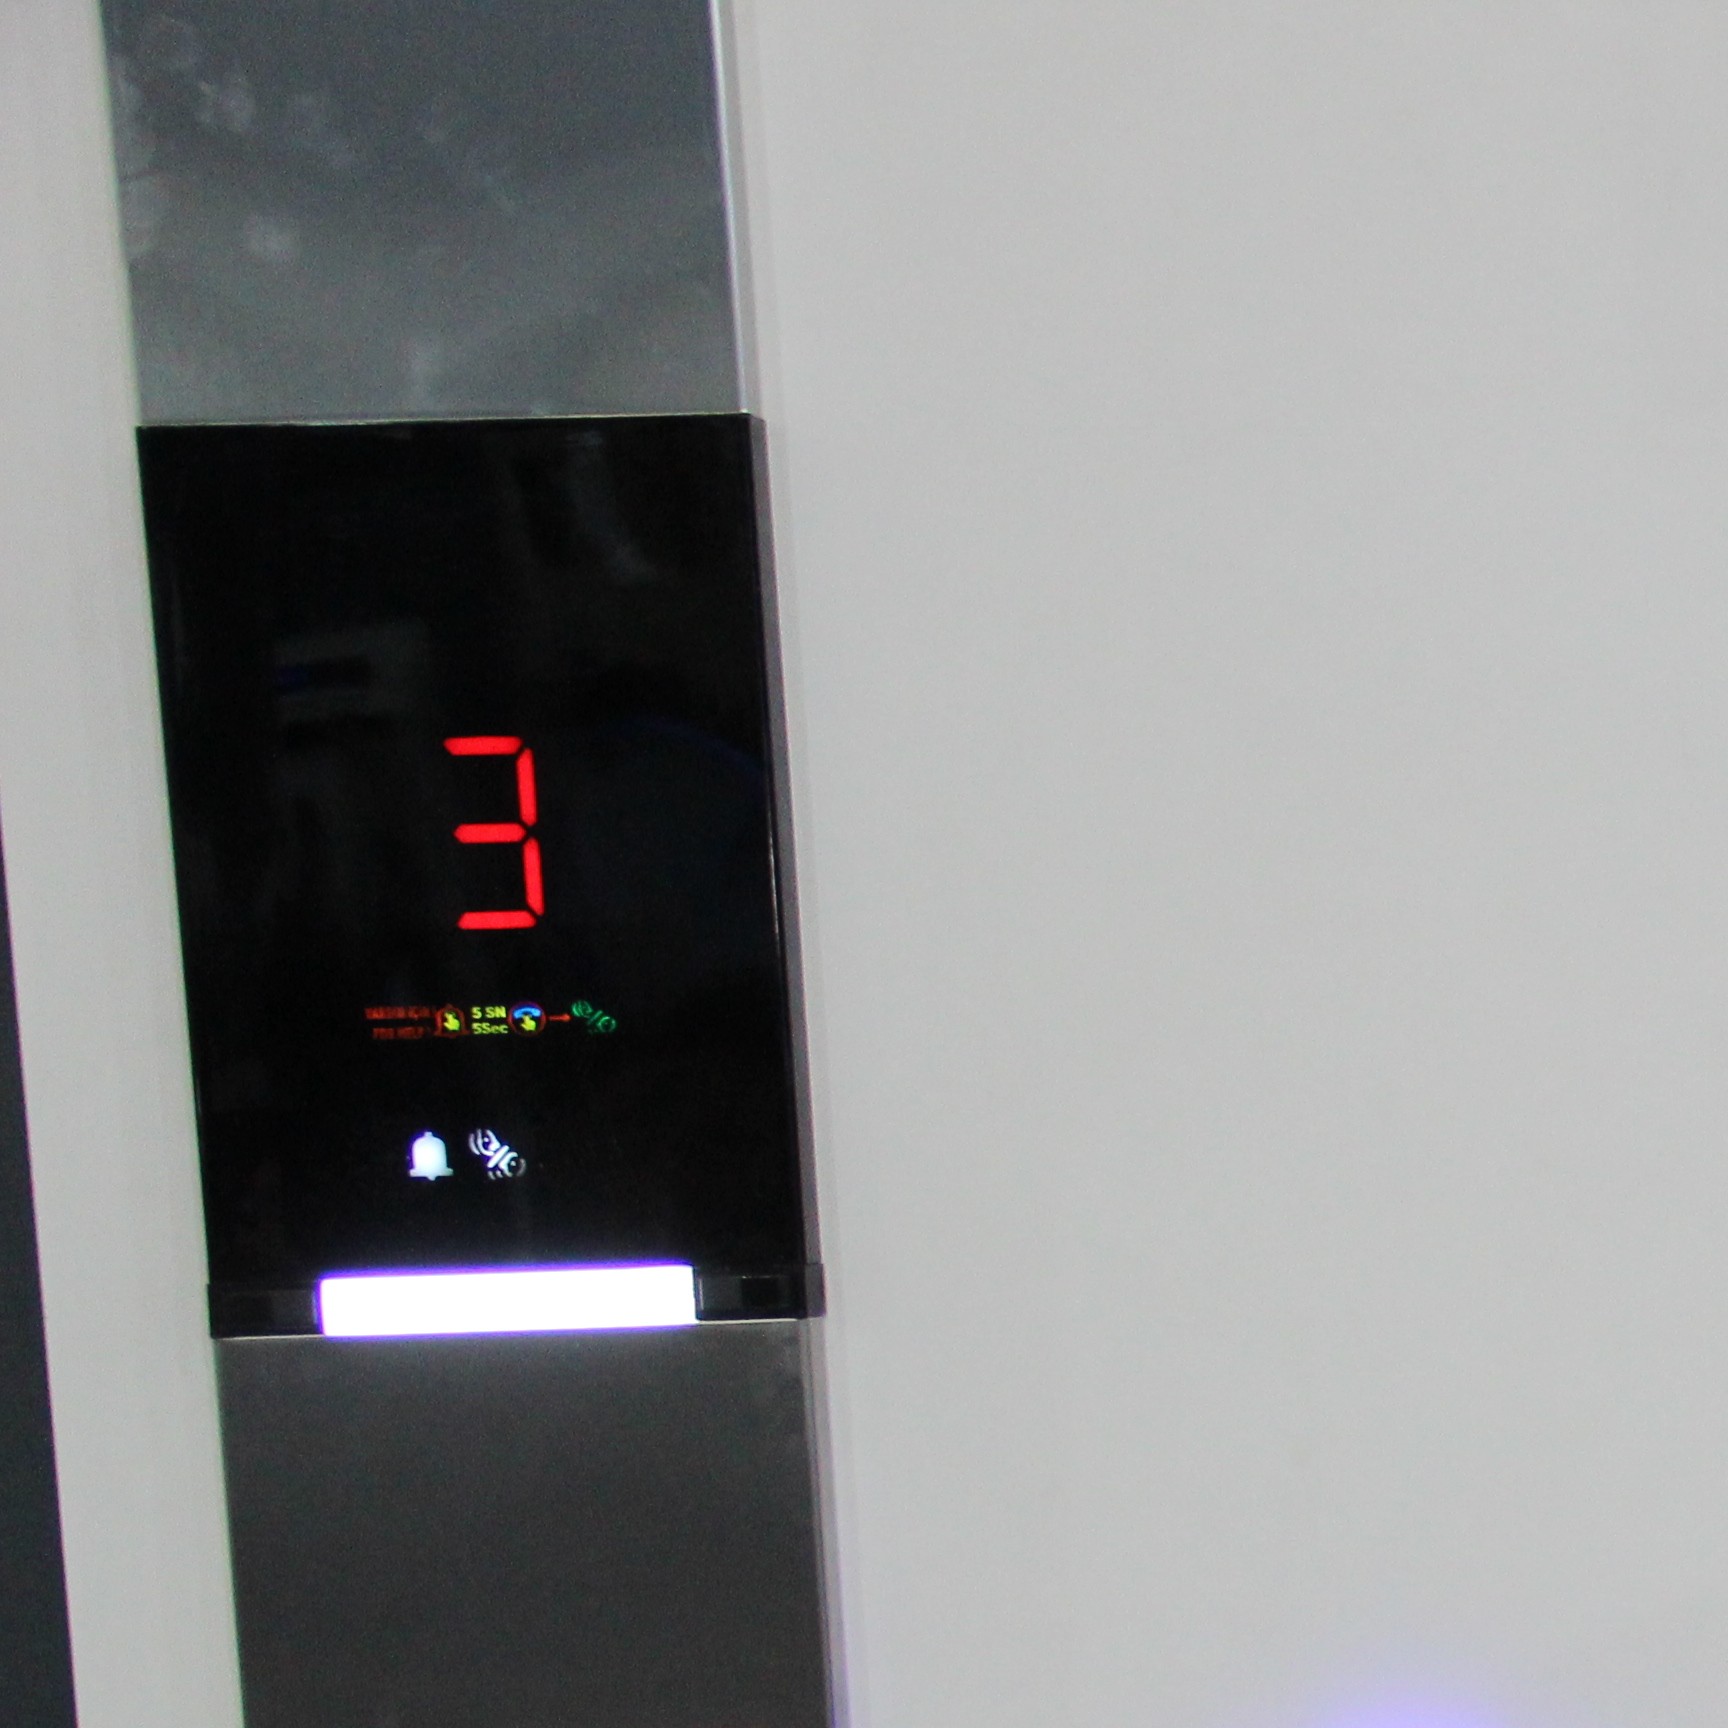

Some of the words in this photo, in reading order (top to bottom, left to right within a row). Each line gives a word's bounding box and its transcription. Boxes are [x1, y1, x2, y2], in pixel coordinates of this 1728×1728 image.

[443, 735, 545, 931] 3
[471, 1006, 482, 1019] 5
[485, 1006, 507, 1018] SN
[471, 1022, 508, 1034] 5Sec
